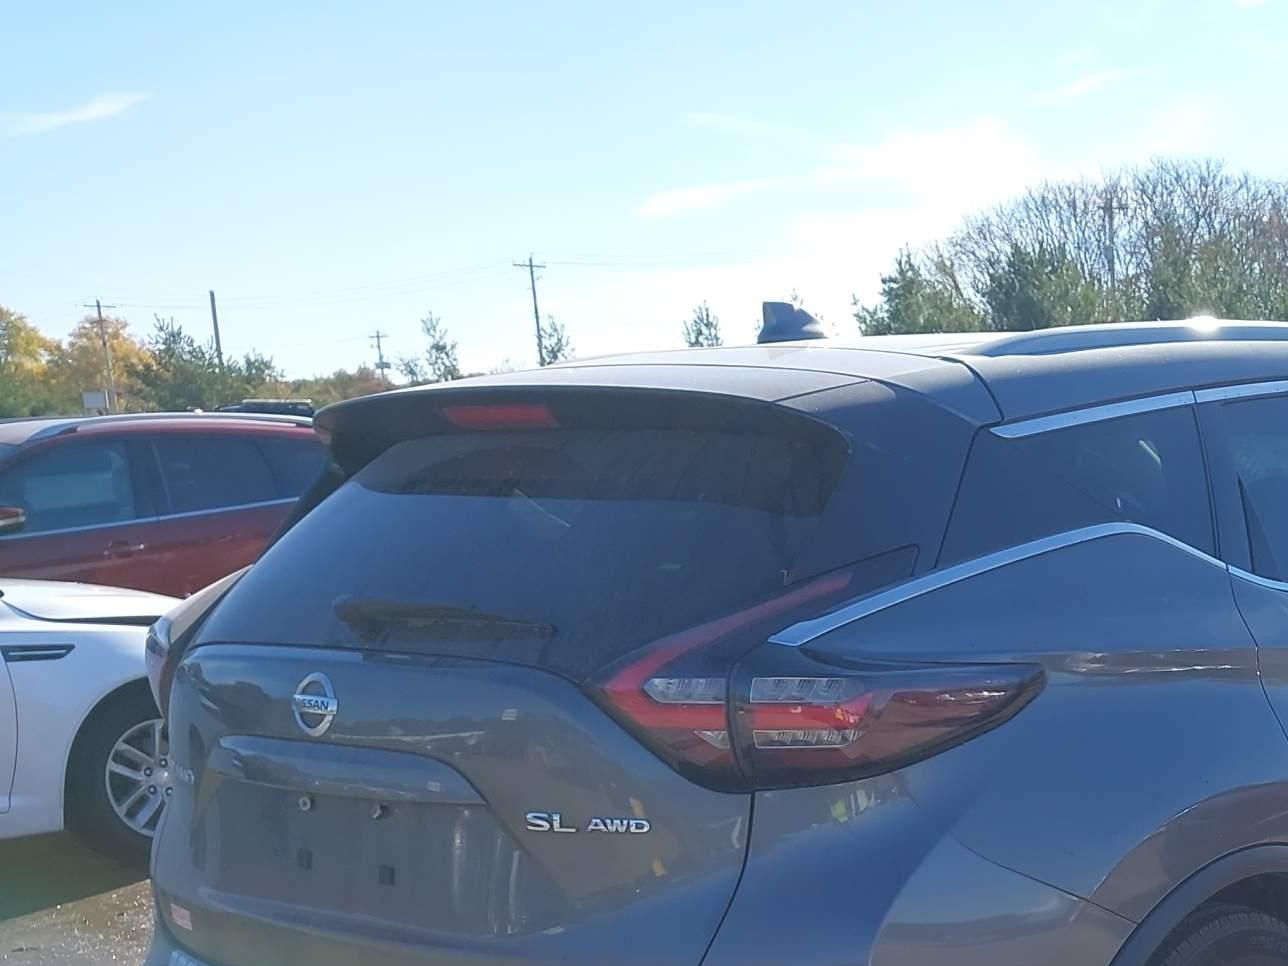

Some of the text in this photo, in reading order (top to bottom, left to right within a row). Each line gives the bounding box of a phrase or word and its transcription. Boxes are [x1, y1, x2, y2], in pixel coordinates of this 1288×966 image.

[296, 698, 329, 710] SSAN
[526, 812, 650, 833] SL AWD
